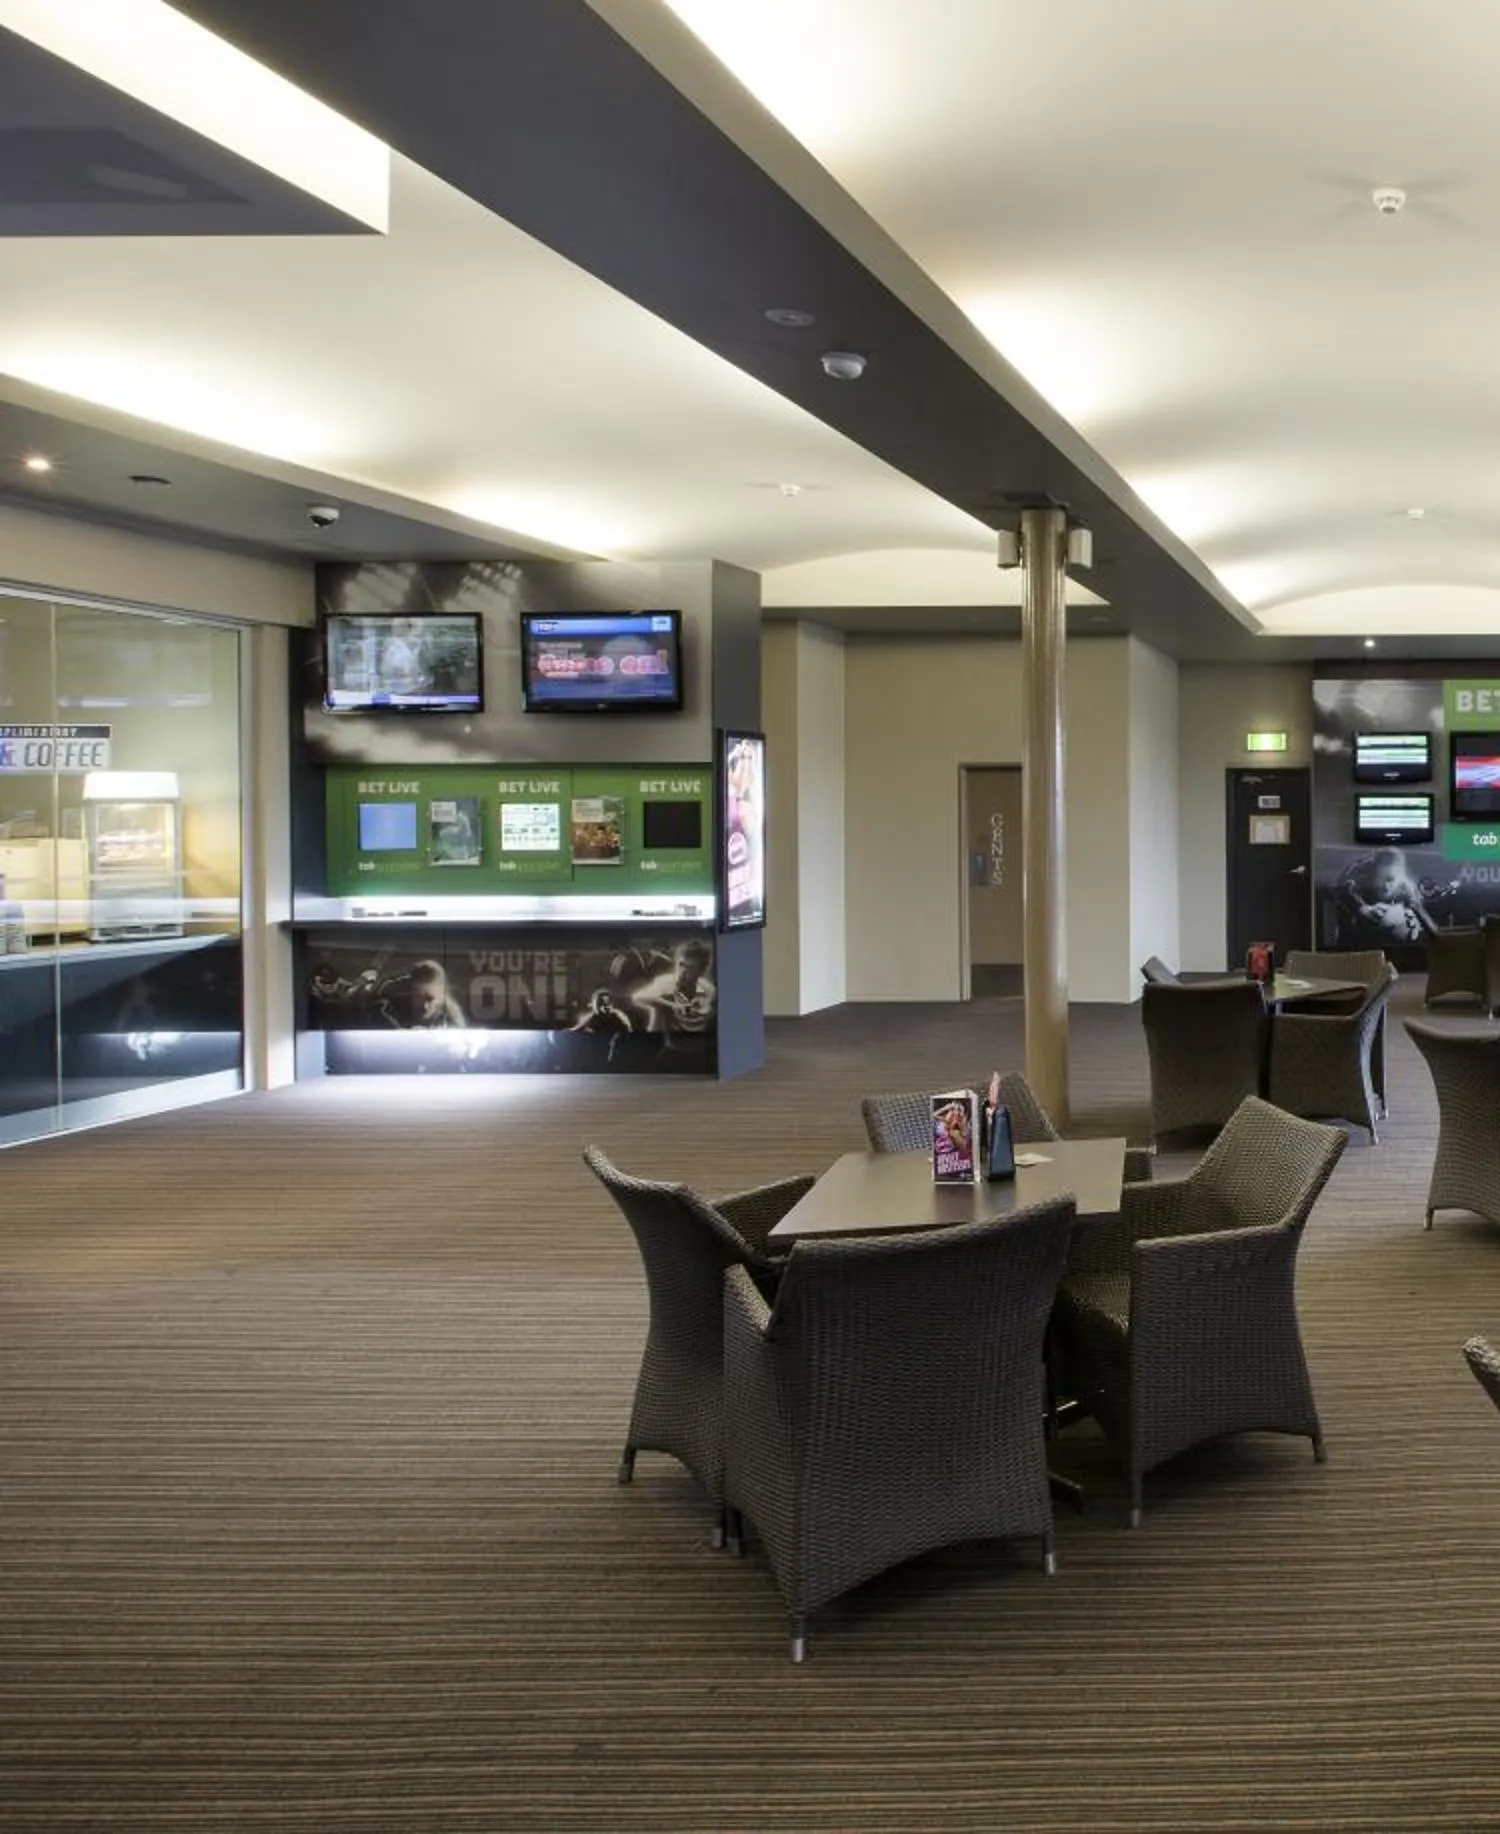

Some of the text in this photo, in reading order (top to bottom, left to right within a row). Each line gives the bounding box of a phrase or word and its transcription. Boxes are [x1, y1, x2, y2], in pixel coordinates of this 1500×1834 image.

[23, 742, 105, 767] COFFEE
[358, 781, 420, 793] BET LIVE
[500, 781, 560, 793] BET LIVE
[640, 780, 701, 793] BET LIVE
[469, 950, 568, 972] YOU'RE
[469, 974, 568, 1020] ON!
